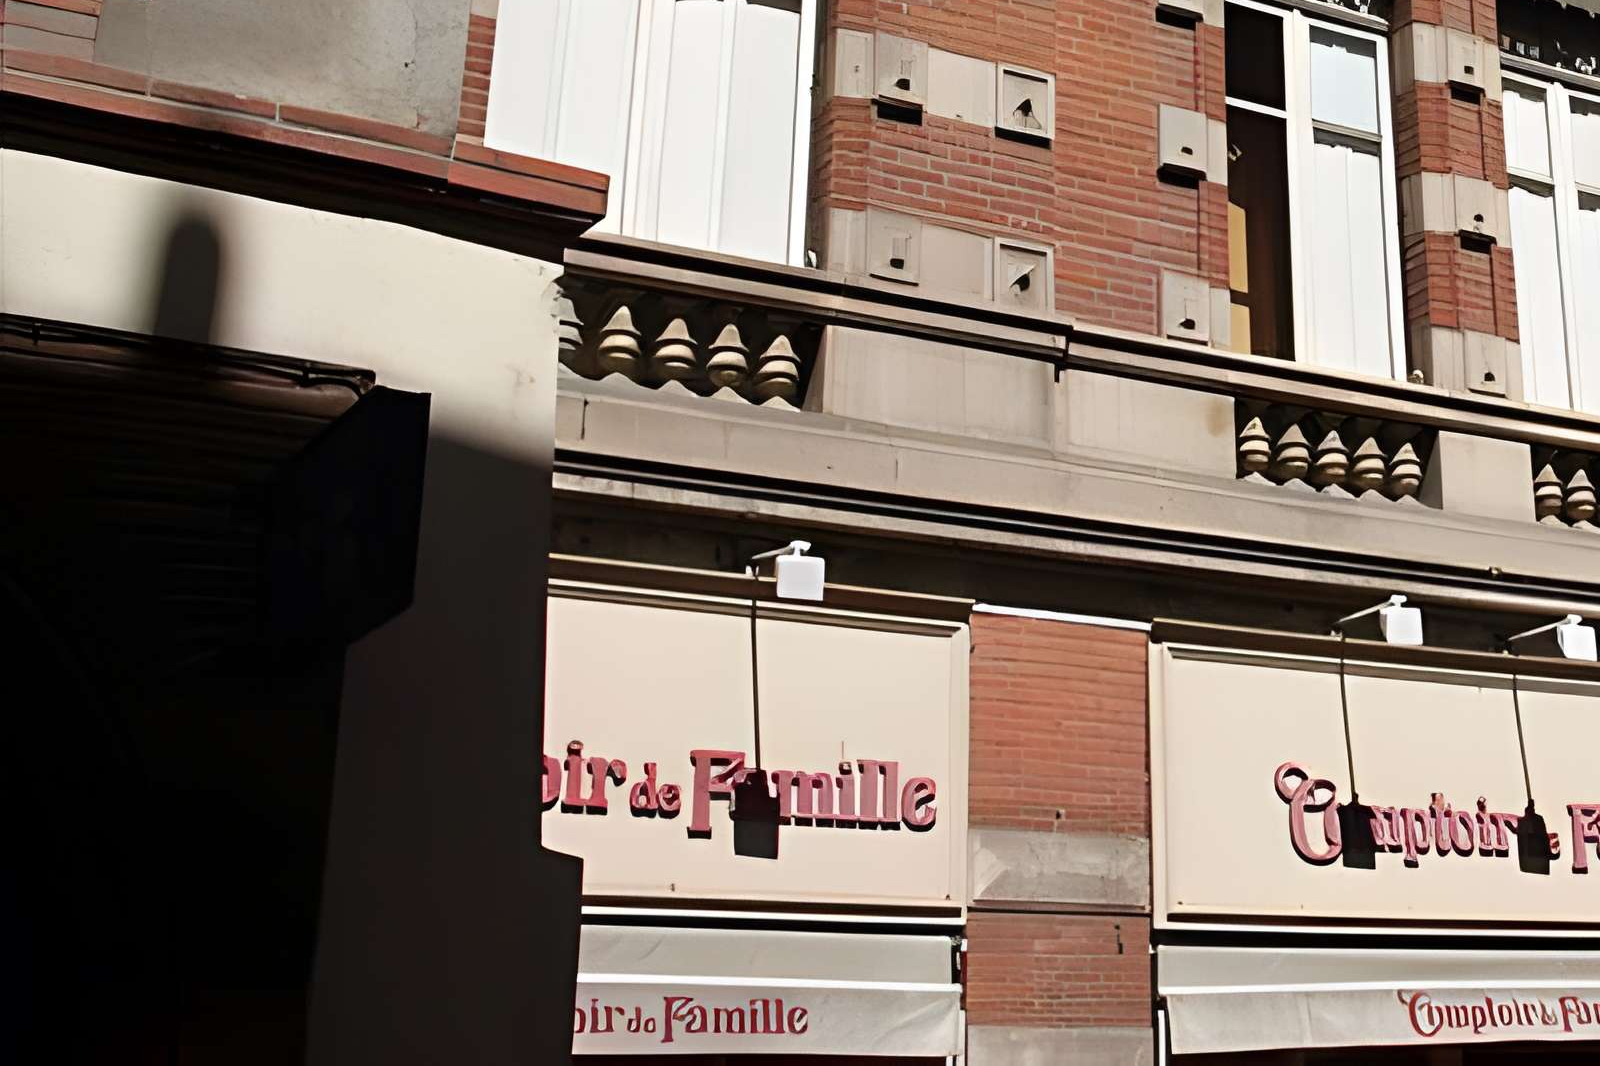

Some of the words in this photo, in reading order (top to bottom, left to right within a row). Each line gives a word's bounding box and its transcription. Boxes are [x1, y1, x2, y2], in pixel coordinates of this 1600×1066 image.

[630, 762, 682, 818] de
[687, 749, 937, 839] Fmille
[661, 997, 808, 1043] Famille
[1397, 989, 1535, 1037] Comptoir
